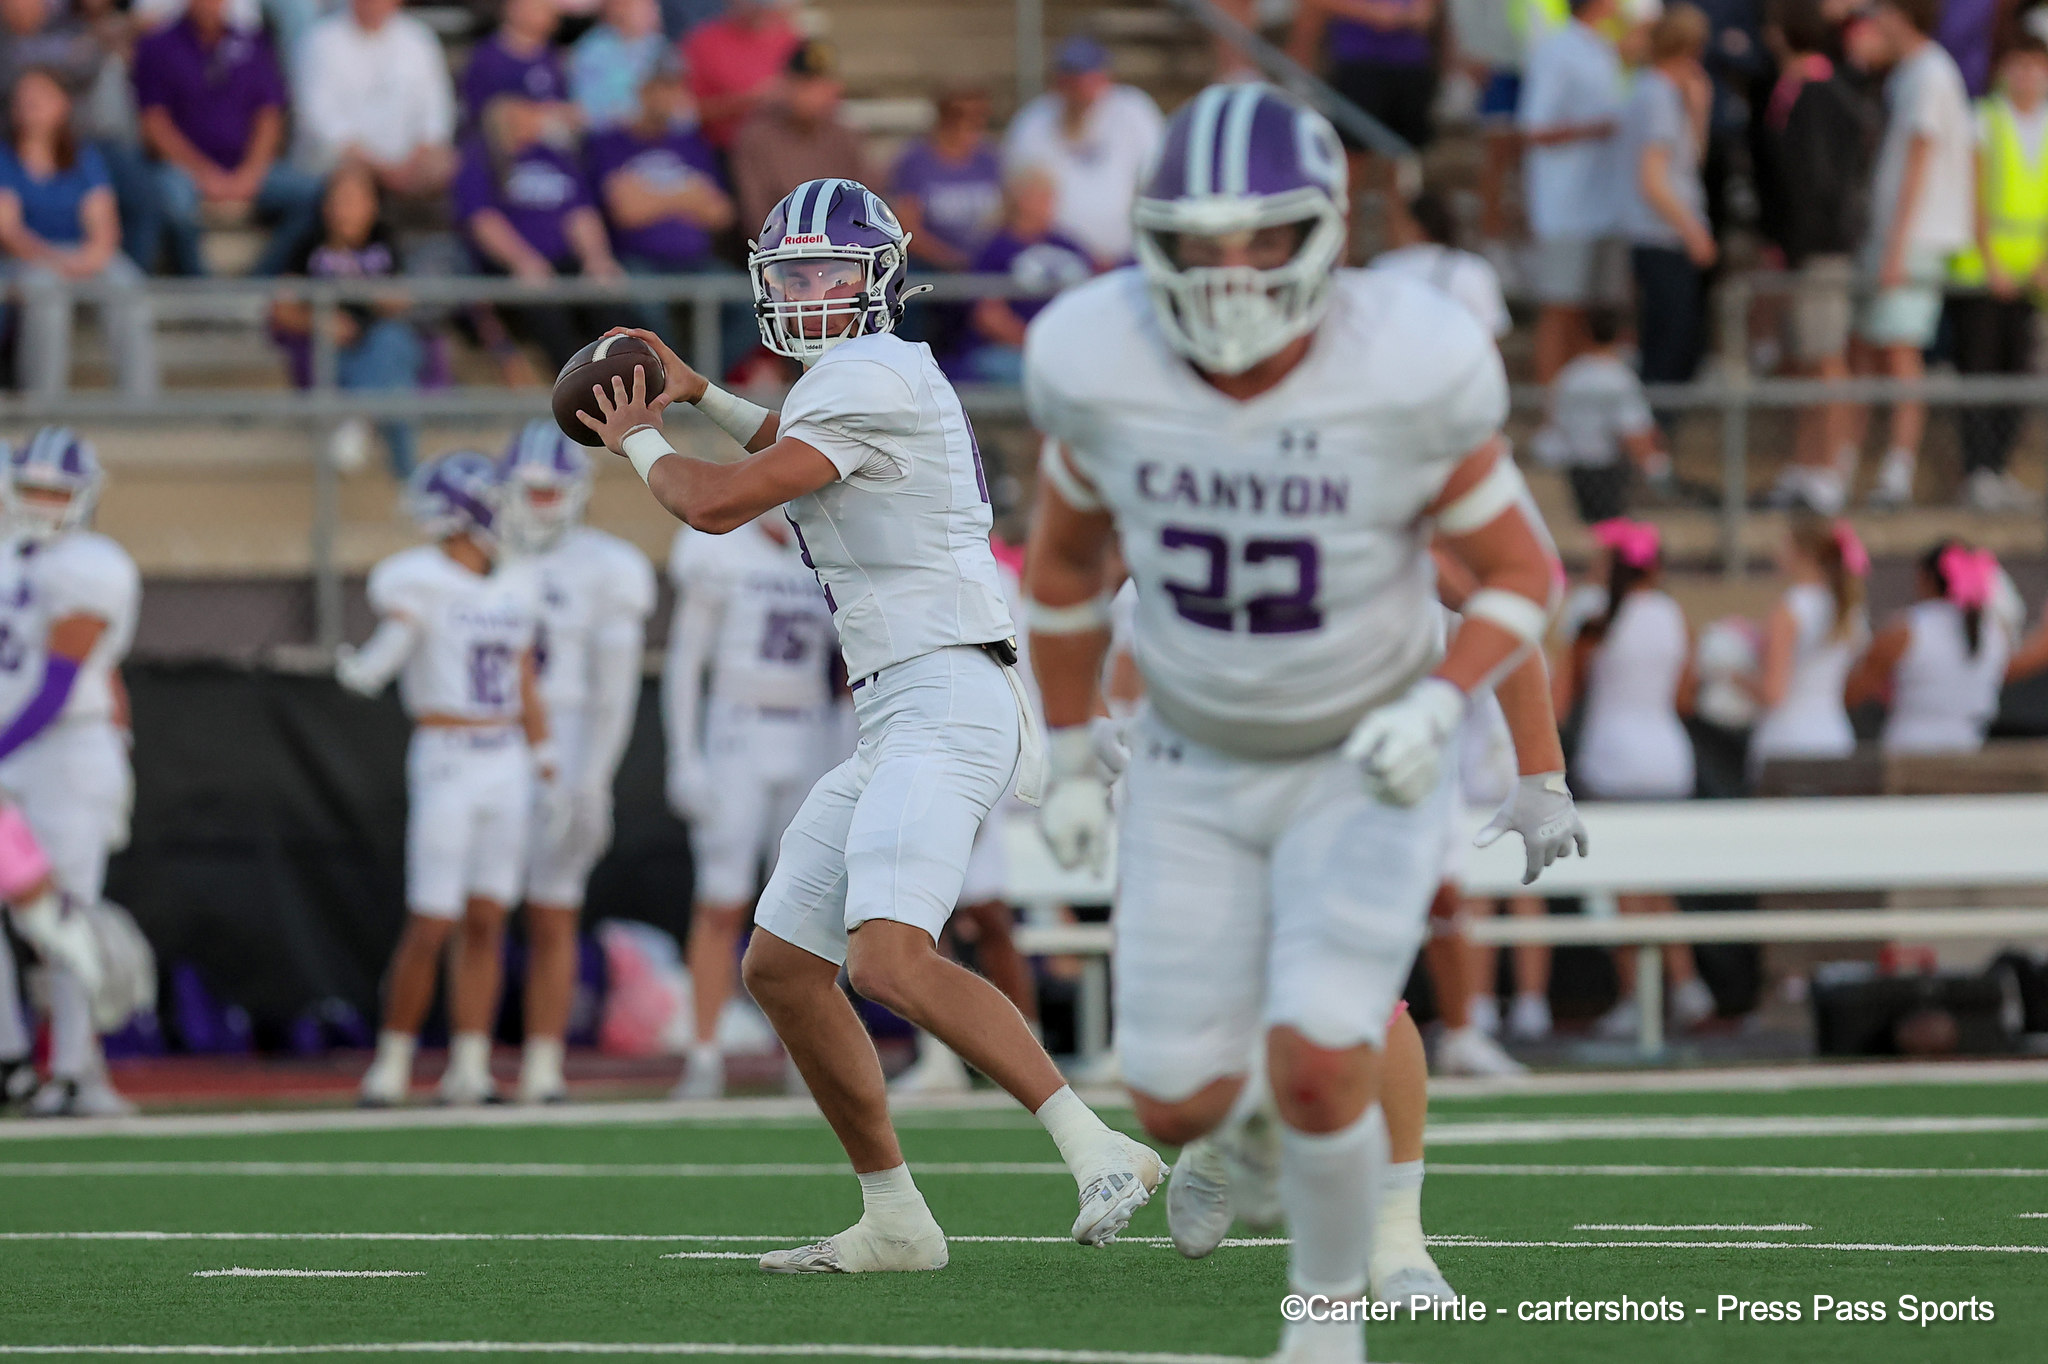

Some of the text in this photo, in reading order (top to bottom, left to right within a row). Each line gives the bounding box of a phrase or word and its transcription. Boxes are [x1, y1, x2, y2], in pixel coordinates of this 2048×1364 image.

[785, 235, 823, 245] Riddell
[1135, 460, 1350, 516] CANYON
[1160, 525, 1326, 634] 22
